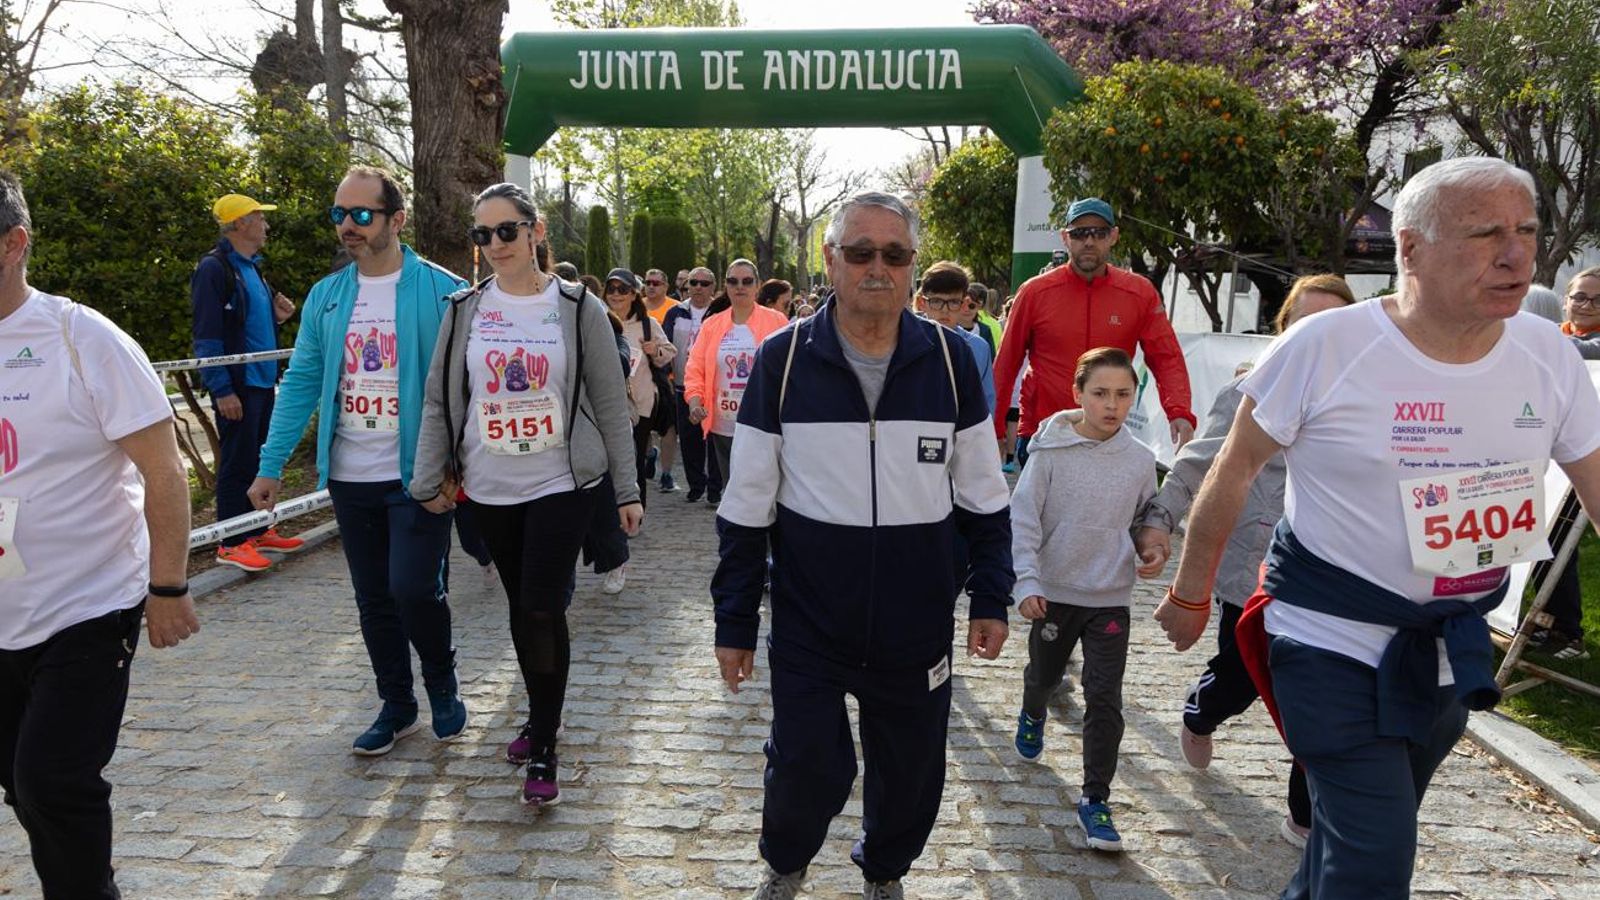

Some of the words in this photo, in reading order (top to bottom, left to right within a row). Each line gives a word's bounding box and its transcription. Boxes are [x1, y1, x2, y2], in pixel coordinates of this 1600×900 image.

[569, 50, 682, 90] JUNTA
[700, 50, 744, 90] DE
[763, 48, 963, 90] ANDALUCIA
[345, 395, 399, 416] 5013
[721, 400, 738, 411] 50
[1393, 402, 1446, 422] XXVII
[488, 415, 554, 440] 5151
[1392, 425, 1427, 435] CARRERA
[1428, 426, 1463, 435] POPULAR
[1424, 498, 1536, 550] 5404
